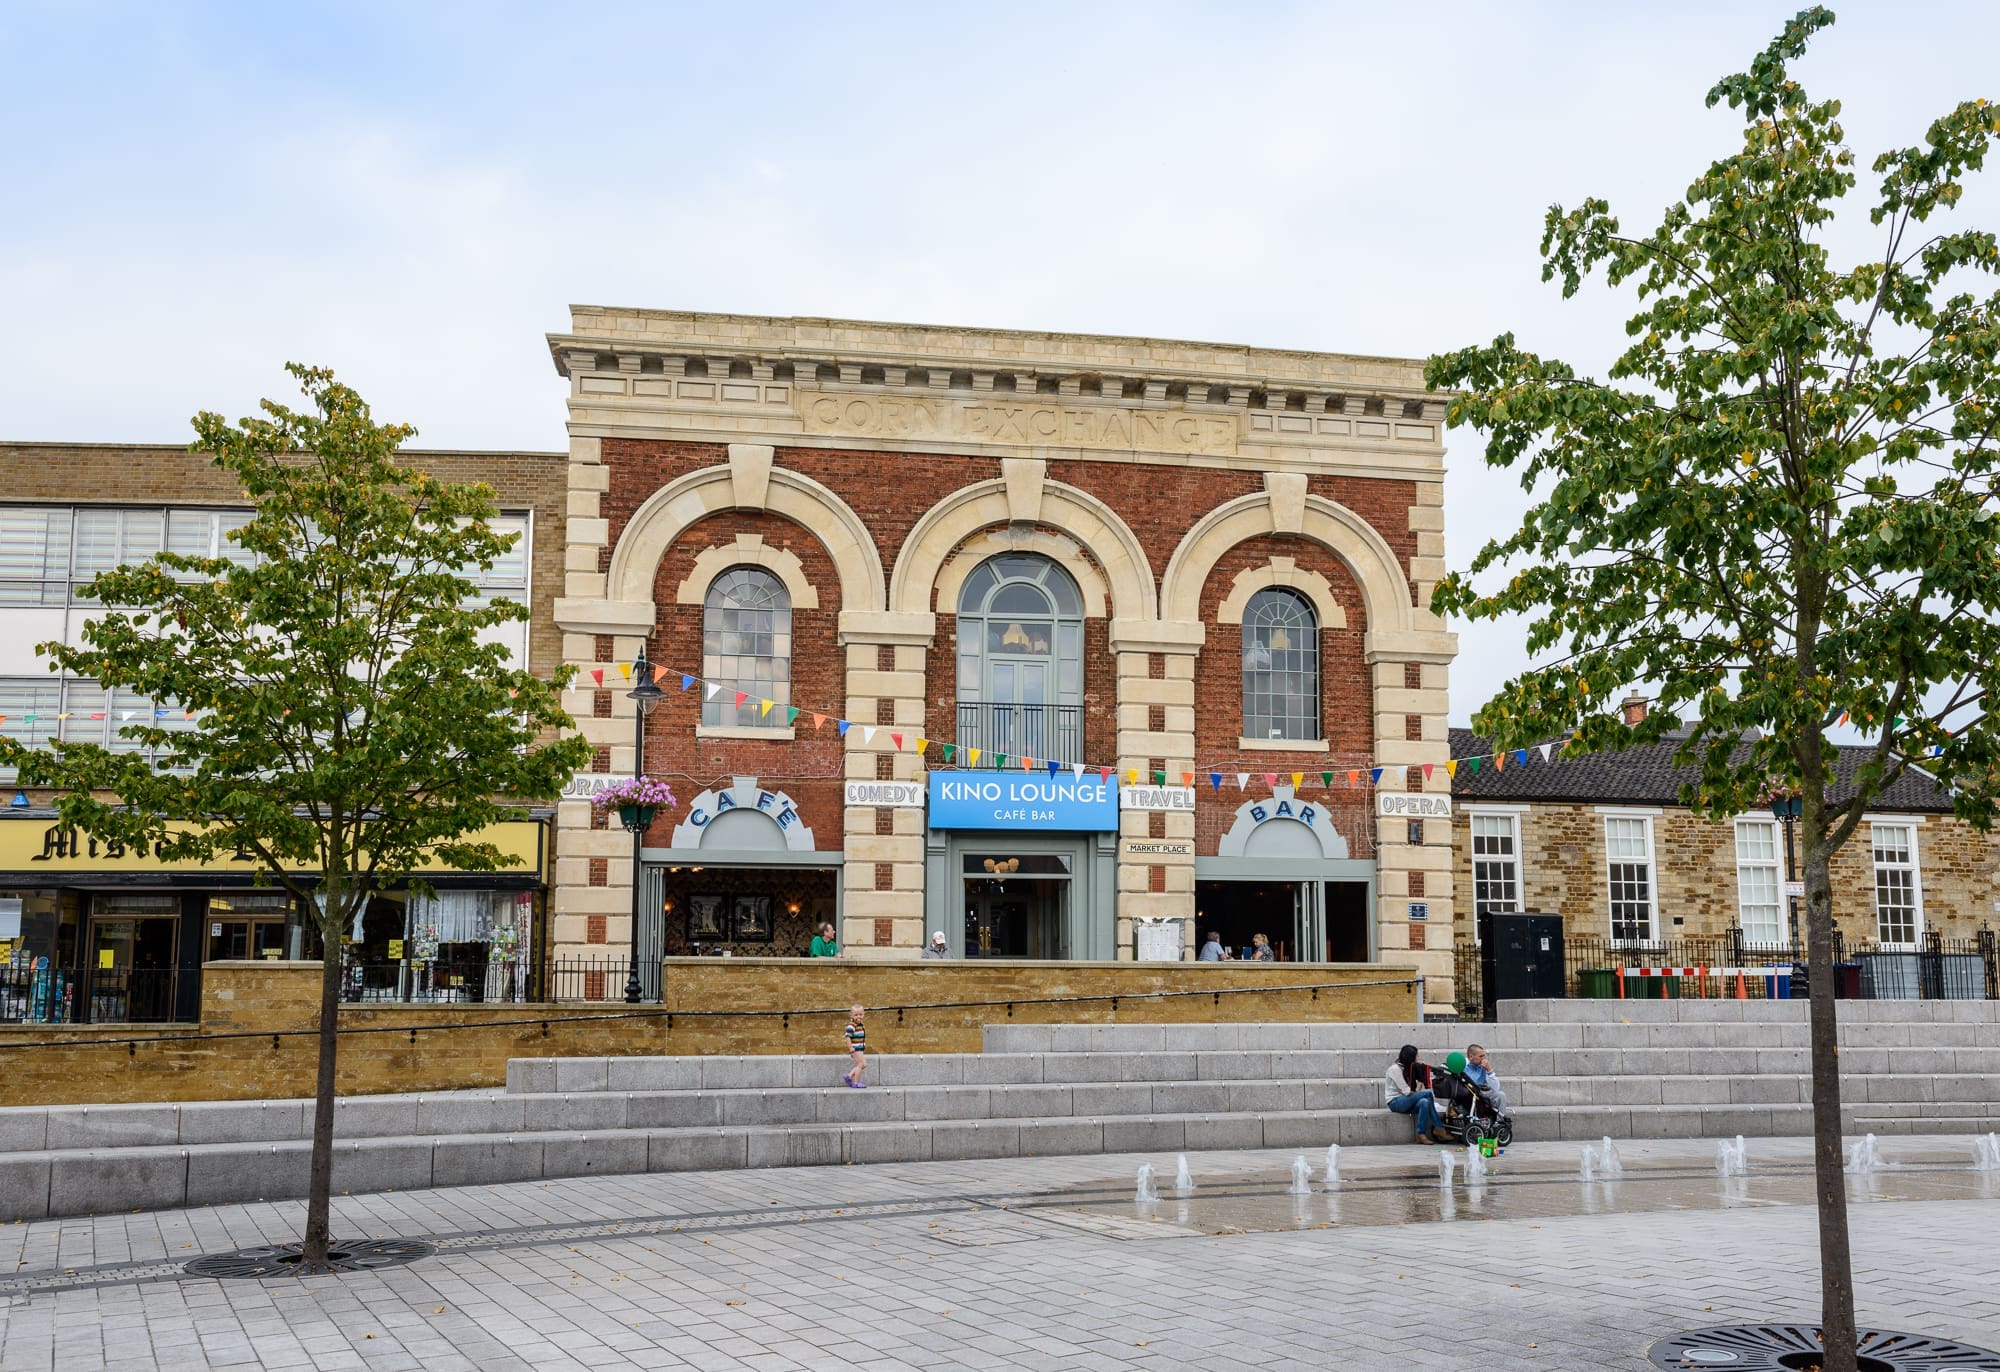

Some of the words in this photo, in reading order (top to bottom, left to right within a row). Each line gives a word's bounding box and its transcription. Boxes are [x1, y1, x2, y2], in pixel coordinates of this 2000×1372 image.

[811, 398, 945, 432] CORN
[962, 406, 1231, 449] EXCHANGE
[847, 784, 919, 802] COMEDY
[941, 782, 1001, 801] KINO
[1010, 783, 1107, 803] LOUNGE
[1128, 789, 1194, 808] TRAVEL
[690, 791, 798, 830] CAFÉ
[993, 808, 1026, 820] CAFÉ
[1031, 811, 1055, 820] BAR
[1250, 800, 1316, 827] BAR
[1382, 796, 1450, 815] OPERA
